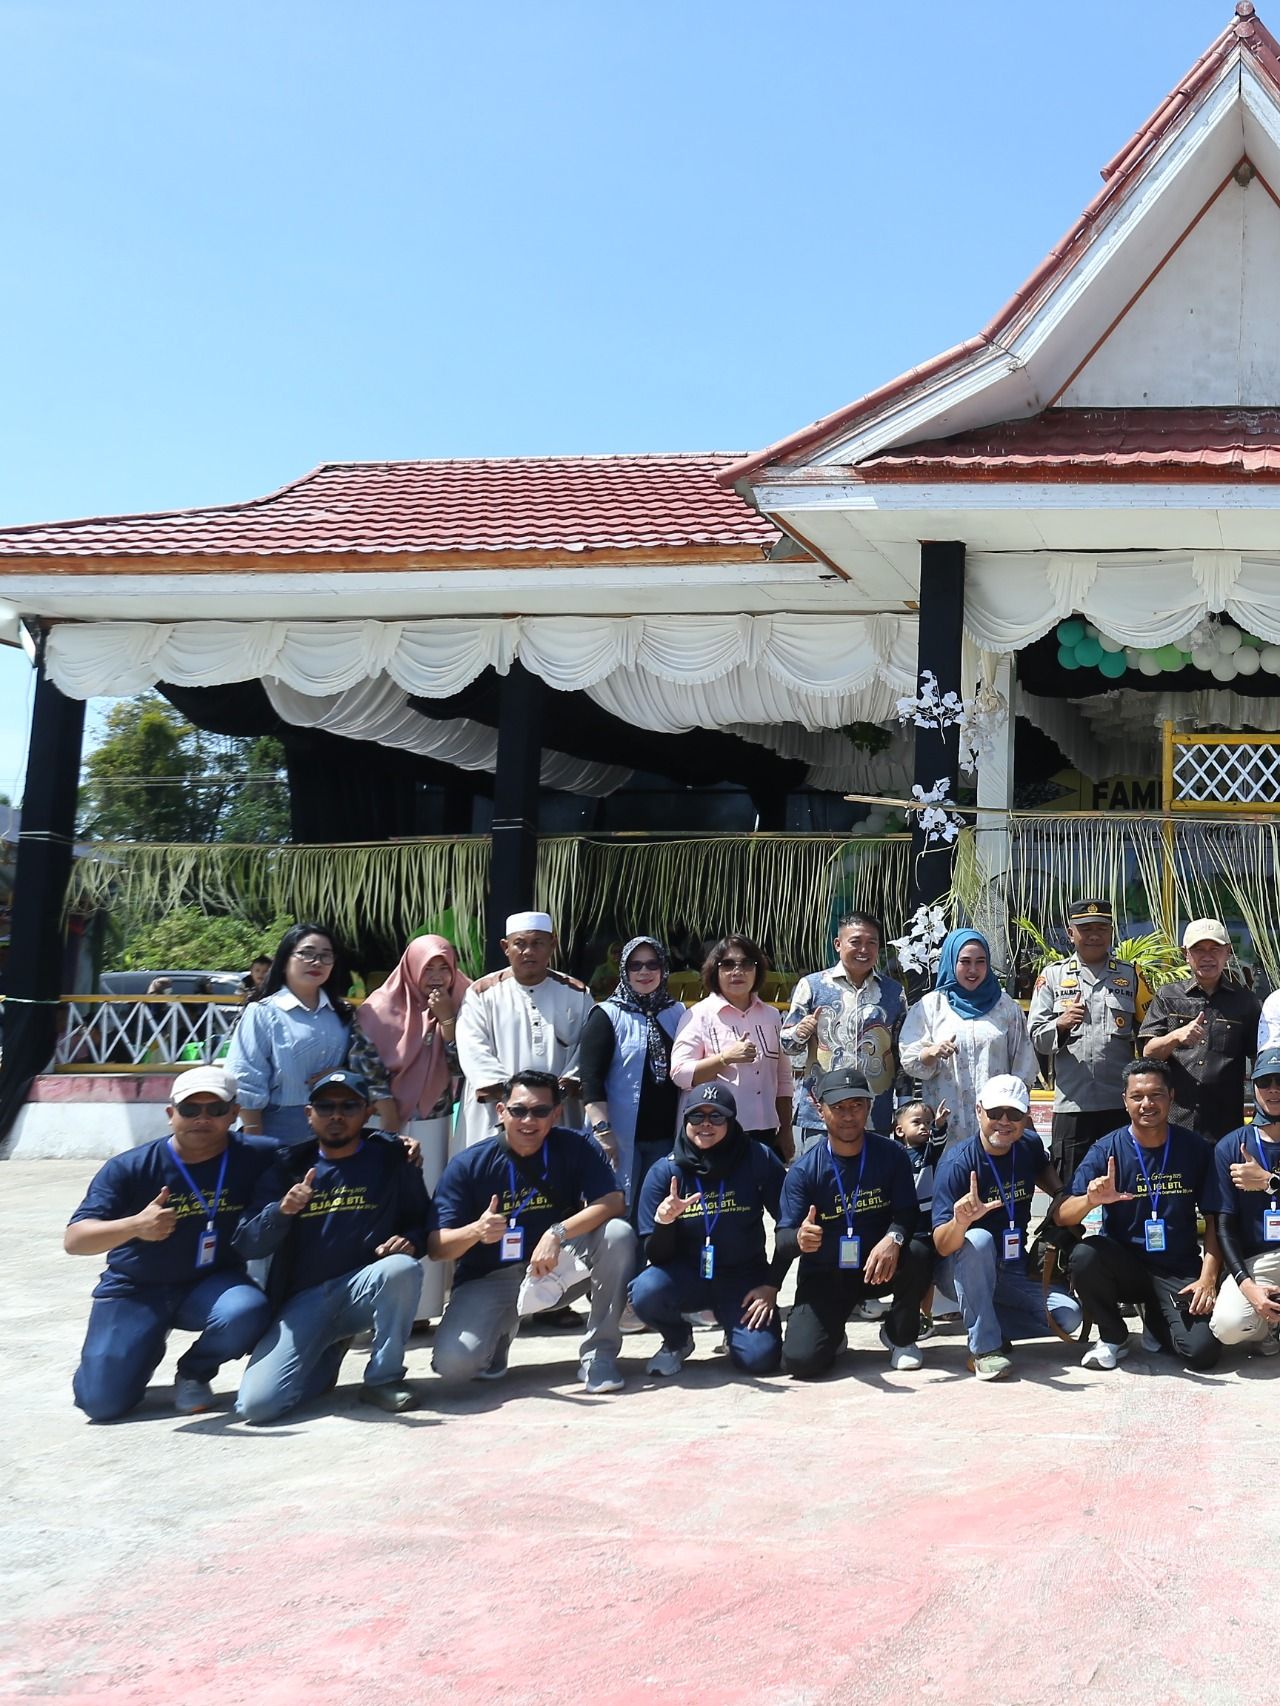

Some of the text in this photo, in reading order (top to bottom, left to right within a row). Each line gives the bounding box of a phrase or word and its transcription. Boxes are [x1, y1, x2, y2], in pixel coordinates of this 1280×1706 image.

[1093, 781, 1163, 810] FAMI
[1109, 988, 1133, 997] POLRI
[1168, 1181, 1183, 1190] BTL
[1014, 1188, 1026, 1198] BTL
[347, 1196, 366, 1205] BTL
[720, 1199, 737, 1208] BTL
[868, 1196, 883, 1205] BTL
